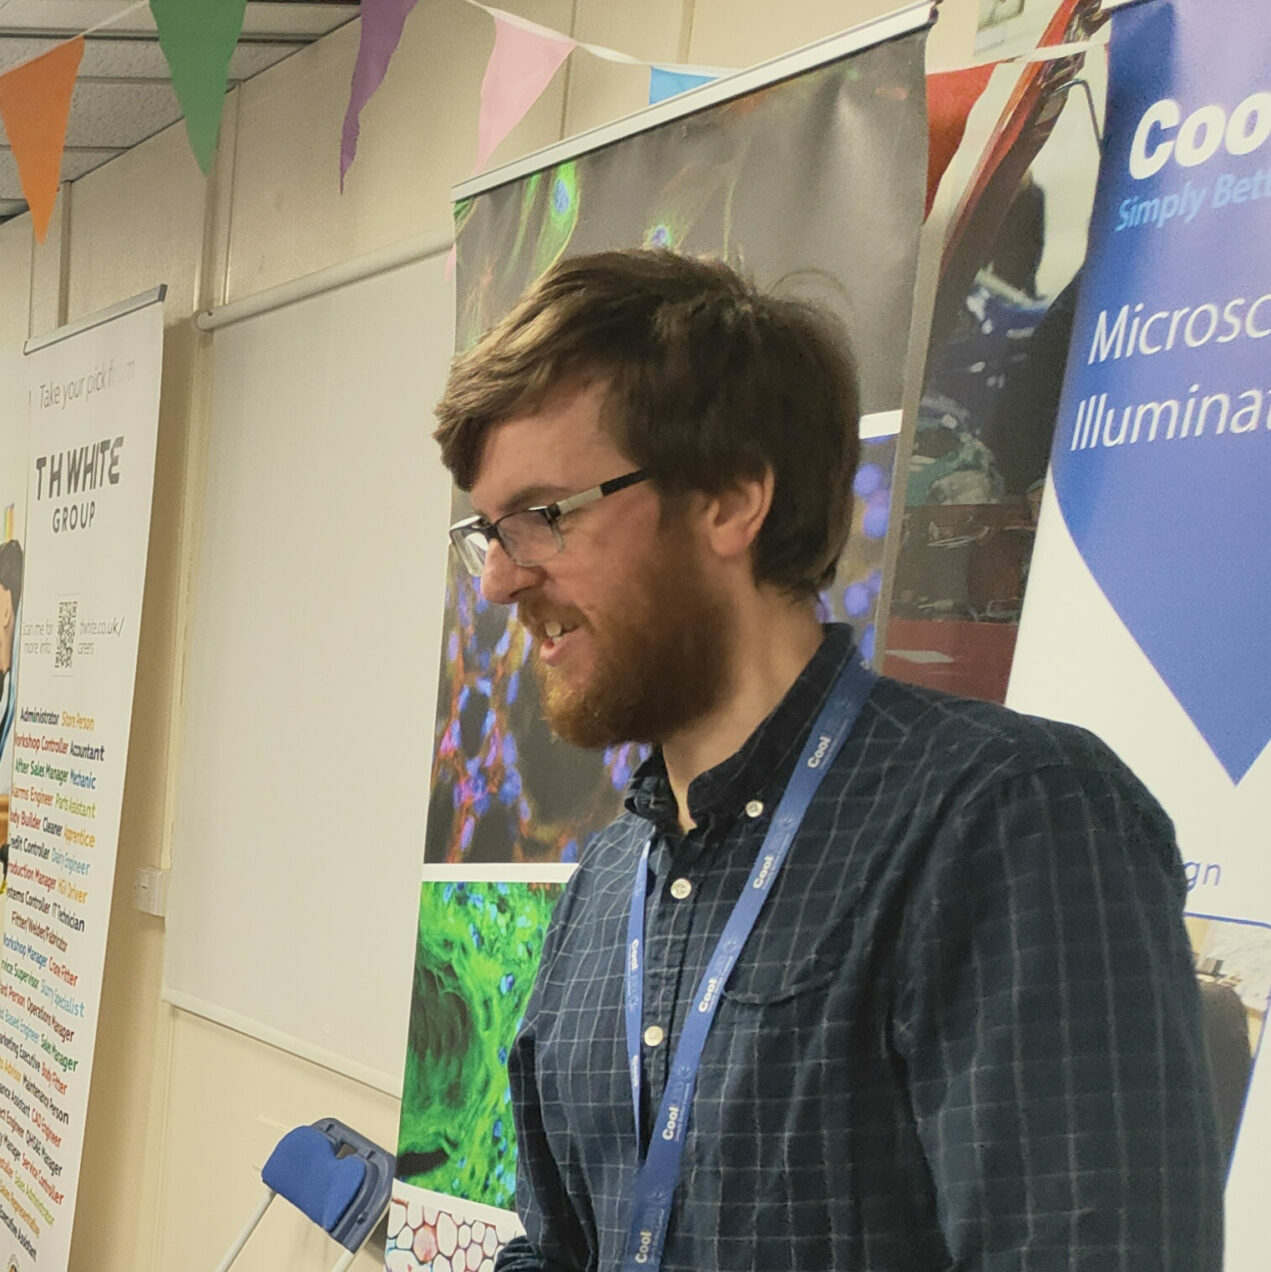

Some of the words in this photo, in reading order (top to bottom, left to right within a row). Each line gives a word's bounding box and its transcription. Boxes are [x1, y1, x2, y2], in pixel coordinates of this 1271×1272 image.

[1114, 182, 1208, 233] Simply
[39, 380, 59, 409] Take
[61, 376, 86, 410] your
[86, 366, 107, 402] pick
[67, 436, 124, 495] WHITE
[52, 500, 96, 534] GROUP
[20, 706, 60, 726] Administrator
[41, 735, 69, 755] Controller
[69, 740, 105, 762] Accountant
[808, 735, 831, 768] Cool
[30, 759, 45, 778] Sales
[45, 761, 69, 787] Manager
[30, 786, 54, 808] Engineer
[20, 810, 41, 830] Builder
[42, 816, 63, 837] Cleaner
[23, 837, 50, 860] Controller
[34, 866, 57, 893] Manager
[753, 853, 774, 889] Cool
[25, 890, 51, 915] Controller
[698, 976, 718, 1013] Cool
[662, 1105, 679, 1140] Cool
[634, 1229, 652, 1264] Cool
